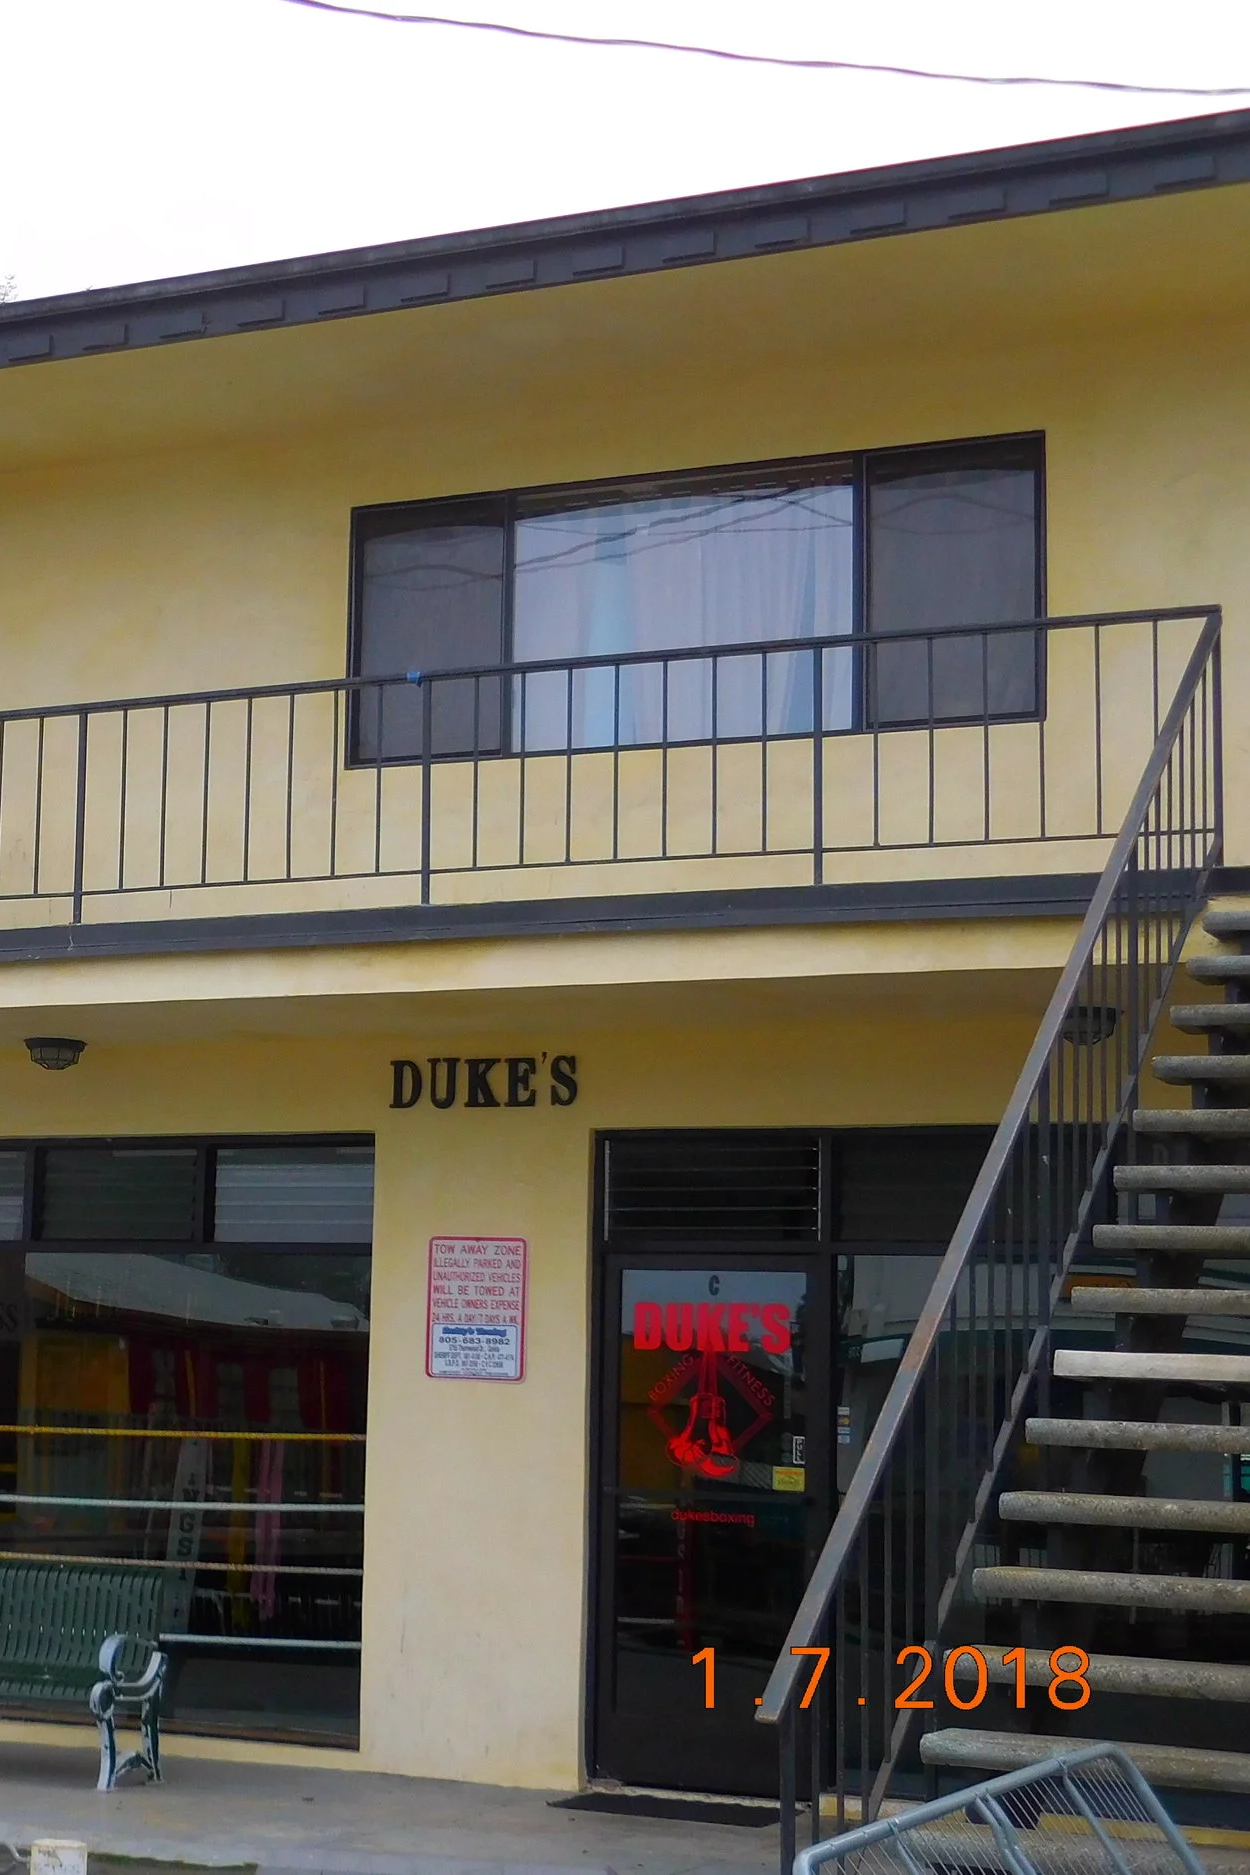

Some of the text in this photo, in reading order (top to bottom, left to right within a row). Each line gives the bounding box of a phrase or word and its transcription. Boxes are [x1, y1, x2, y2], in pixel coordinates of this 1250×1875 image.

[389, 1052, 578, 1109] DUKE'S
[434, 1244, 521, 1256] TOW AWAY ZONE
[433, 1258, 469, 1268] ILLEGALLY
[473, 1258, 502, 1269] PARKED
[433, 1284, 521, 1297] WILL BE TOWED AT
[708, 1275, 720, 1296] C
[633, 1301, 792, 1354] DUKE'S
[648, 1352, 777, 1408] BOXING FITNESS
